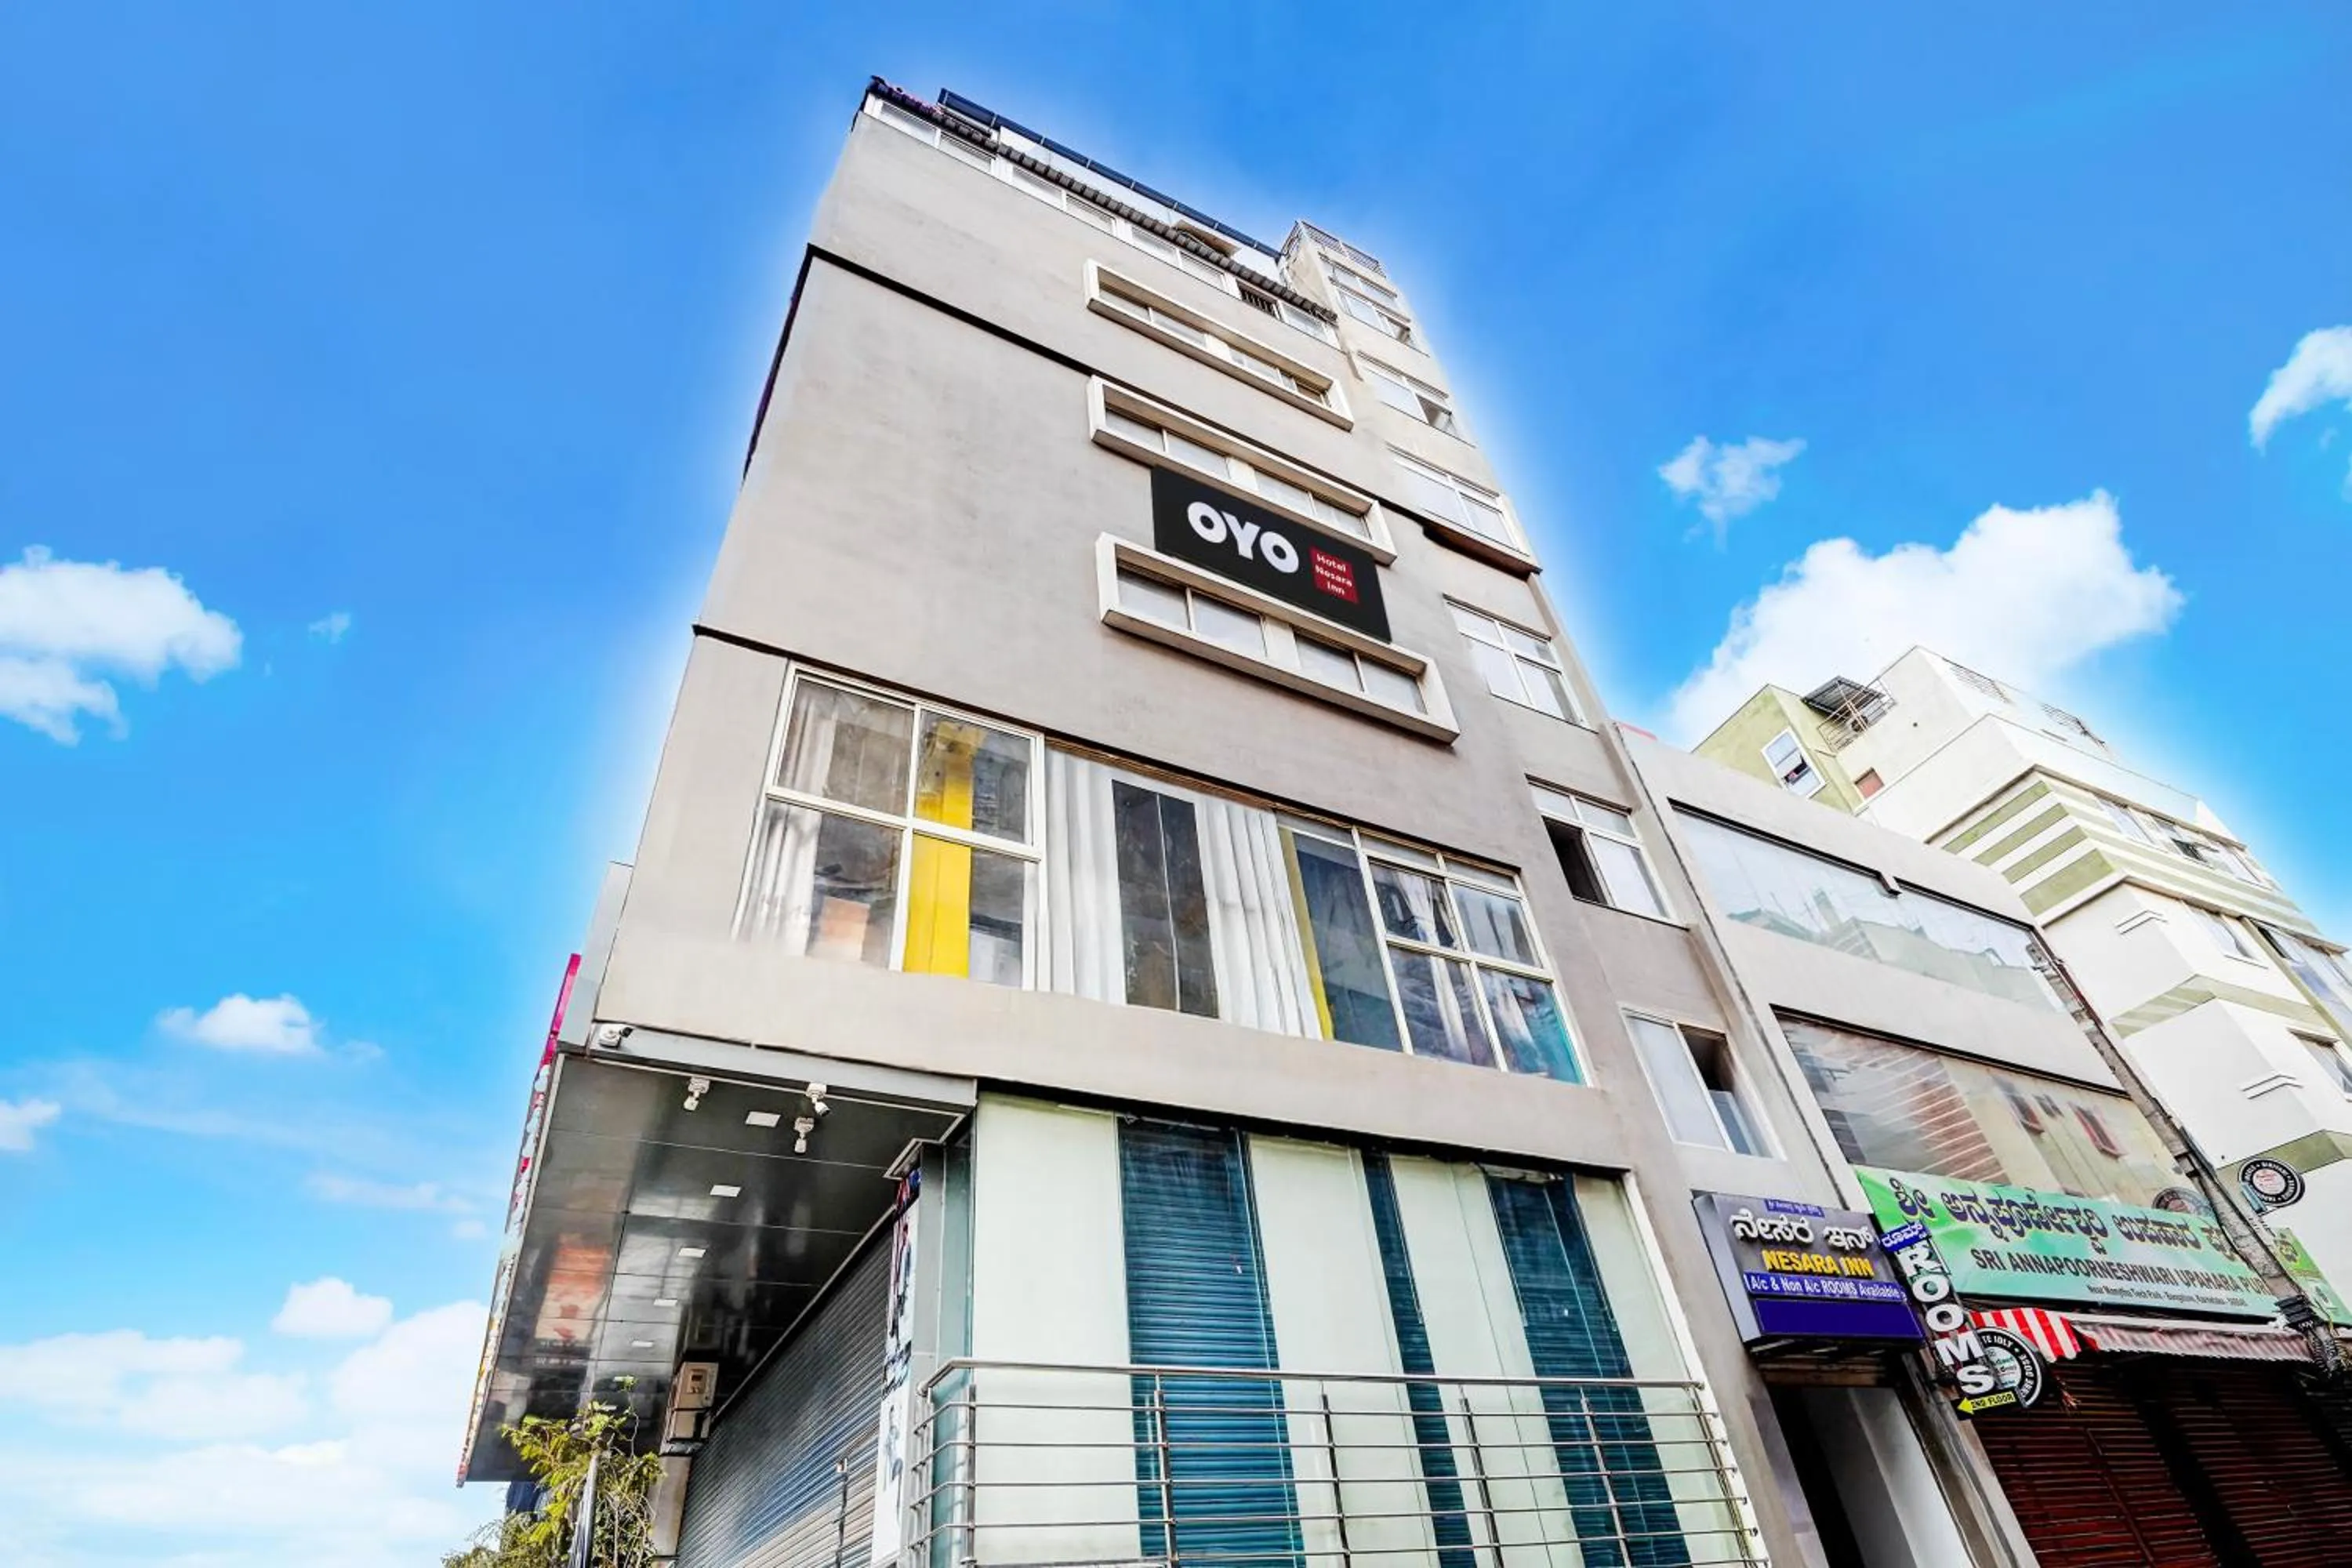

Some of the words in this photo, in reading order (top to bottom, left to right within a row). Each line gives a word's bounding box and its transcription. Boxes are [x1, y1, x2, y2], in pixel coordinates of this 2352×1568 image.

[1187, 501, 1299, 573] OYO
[1316, 553, 1346, 572] Hotel
[1315, 564, 1352, 586] Nesara
[1327, 580, 1345, 596] Inn
[1762, 1249, 1841, 1276] NESARA
[1840, 1257, 1875, 1277] INN
[1970, 1248, 2007, 1271] SRI
[2007, 1252, 2179, 1286] ANNAPOORNESHWARI
[1783, 1276, 1803, 1293] Non
[1823, 1279, 1857, 1296] ROOMS
[1859, 1283, 1901, 1300] Available
[1894, 1239, 1995, 1395] ROOMS
[1987, 1393, 2015, 1406] FLOOR
